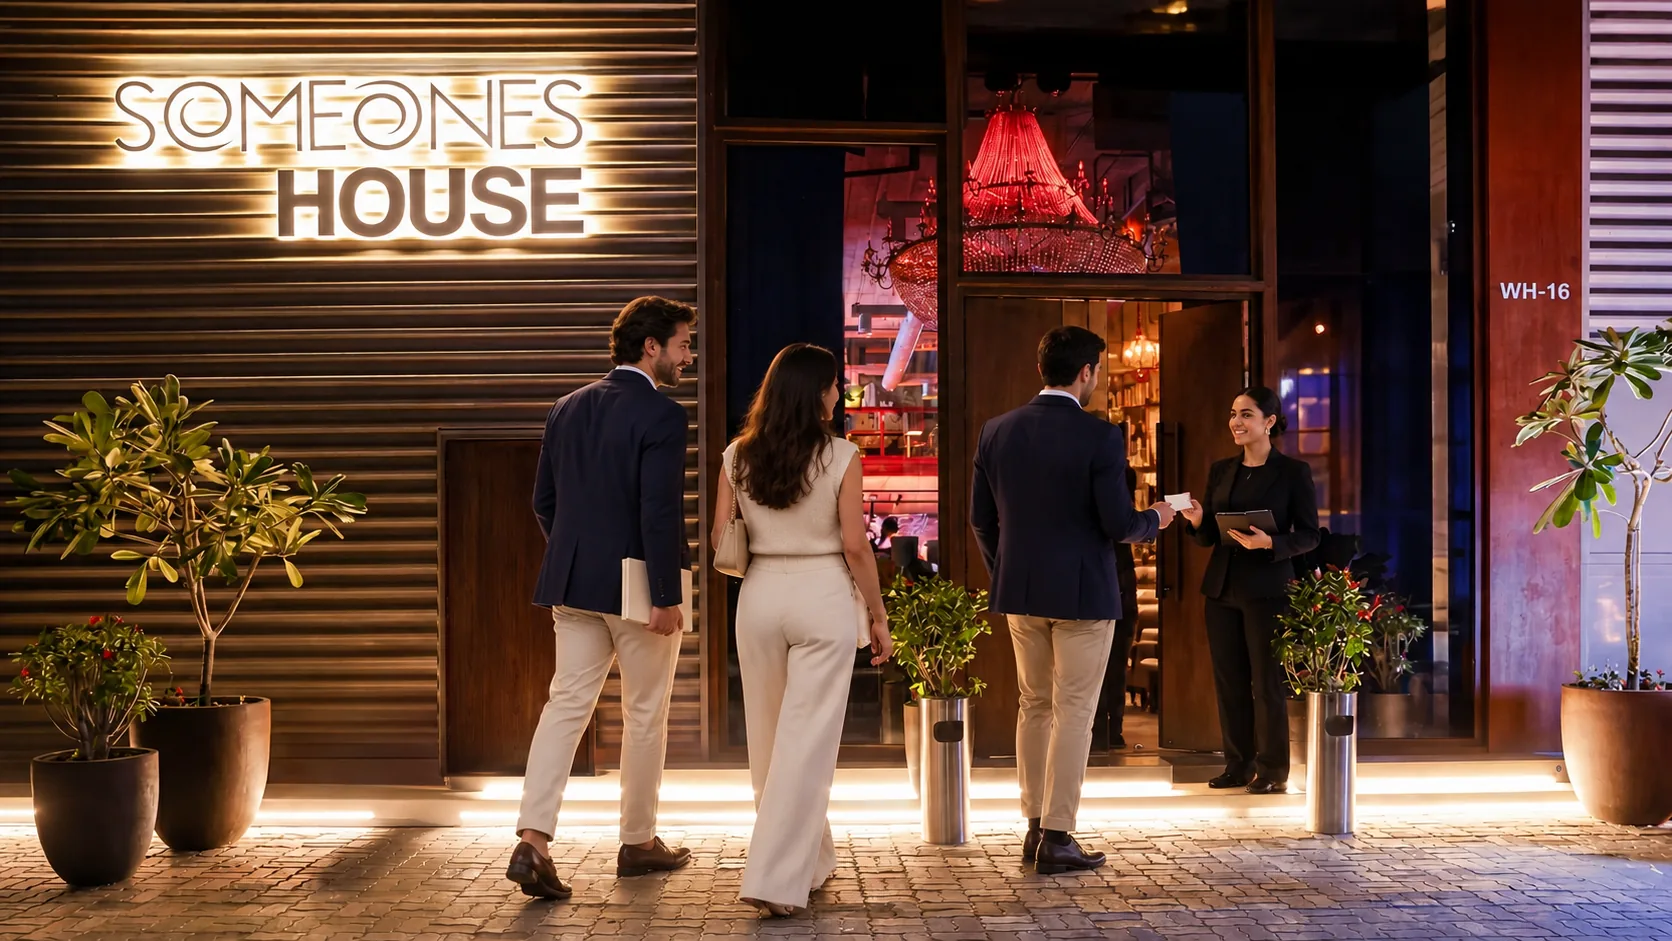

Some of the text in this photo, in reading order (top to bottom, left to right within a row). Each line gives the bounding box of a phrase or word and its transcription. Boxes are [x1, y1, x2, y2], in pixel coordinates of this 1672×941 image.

[115, 79, 583, 152] SOMEONES
[277, 166, 584, 237] HOUSE
[1500, 282, 1570, 300] WH-16
